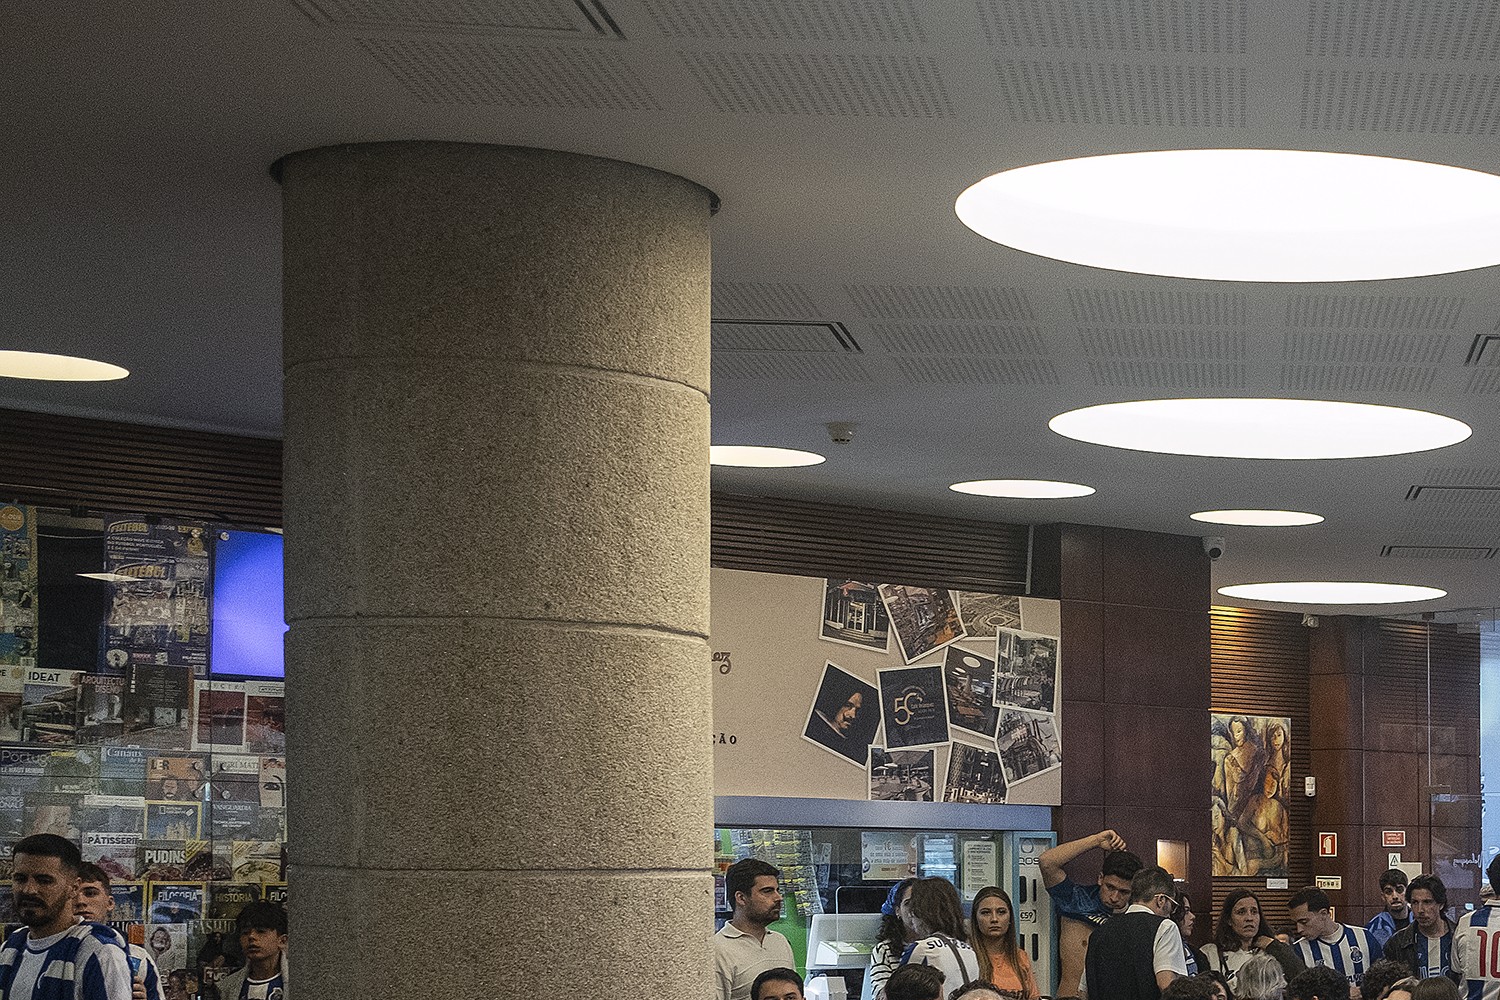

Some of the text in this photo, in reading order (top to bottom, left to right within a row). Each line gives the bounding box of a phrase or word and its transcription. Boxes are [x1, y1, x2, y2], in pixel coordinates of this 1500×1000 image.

[28, 671, 61, 682] IDEAT
[150, 759, 170, 771] LER
[144, 849, 186, 864] PUDINS
